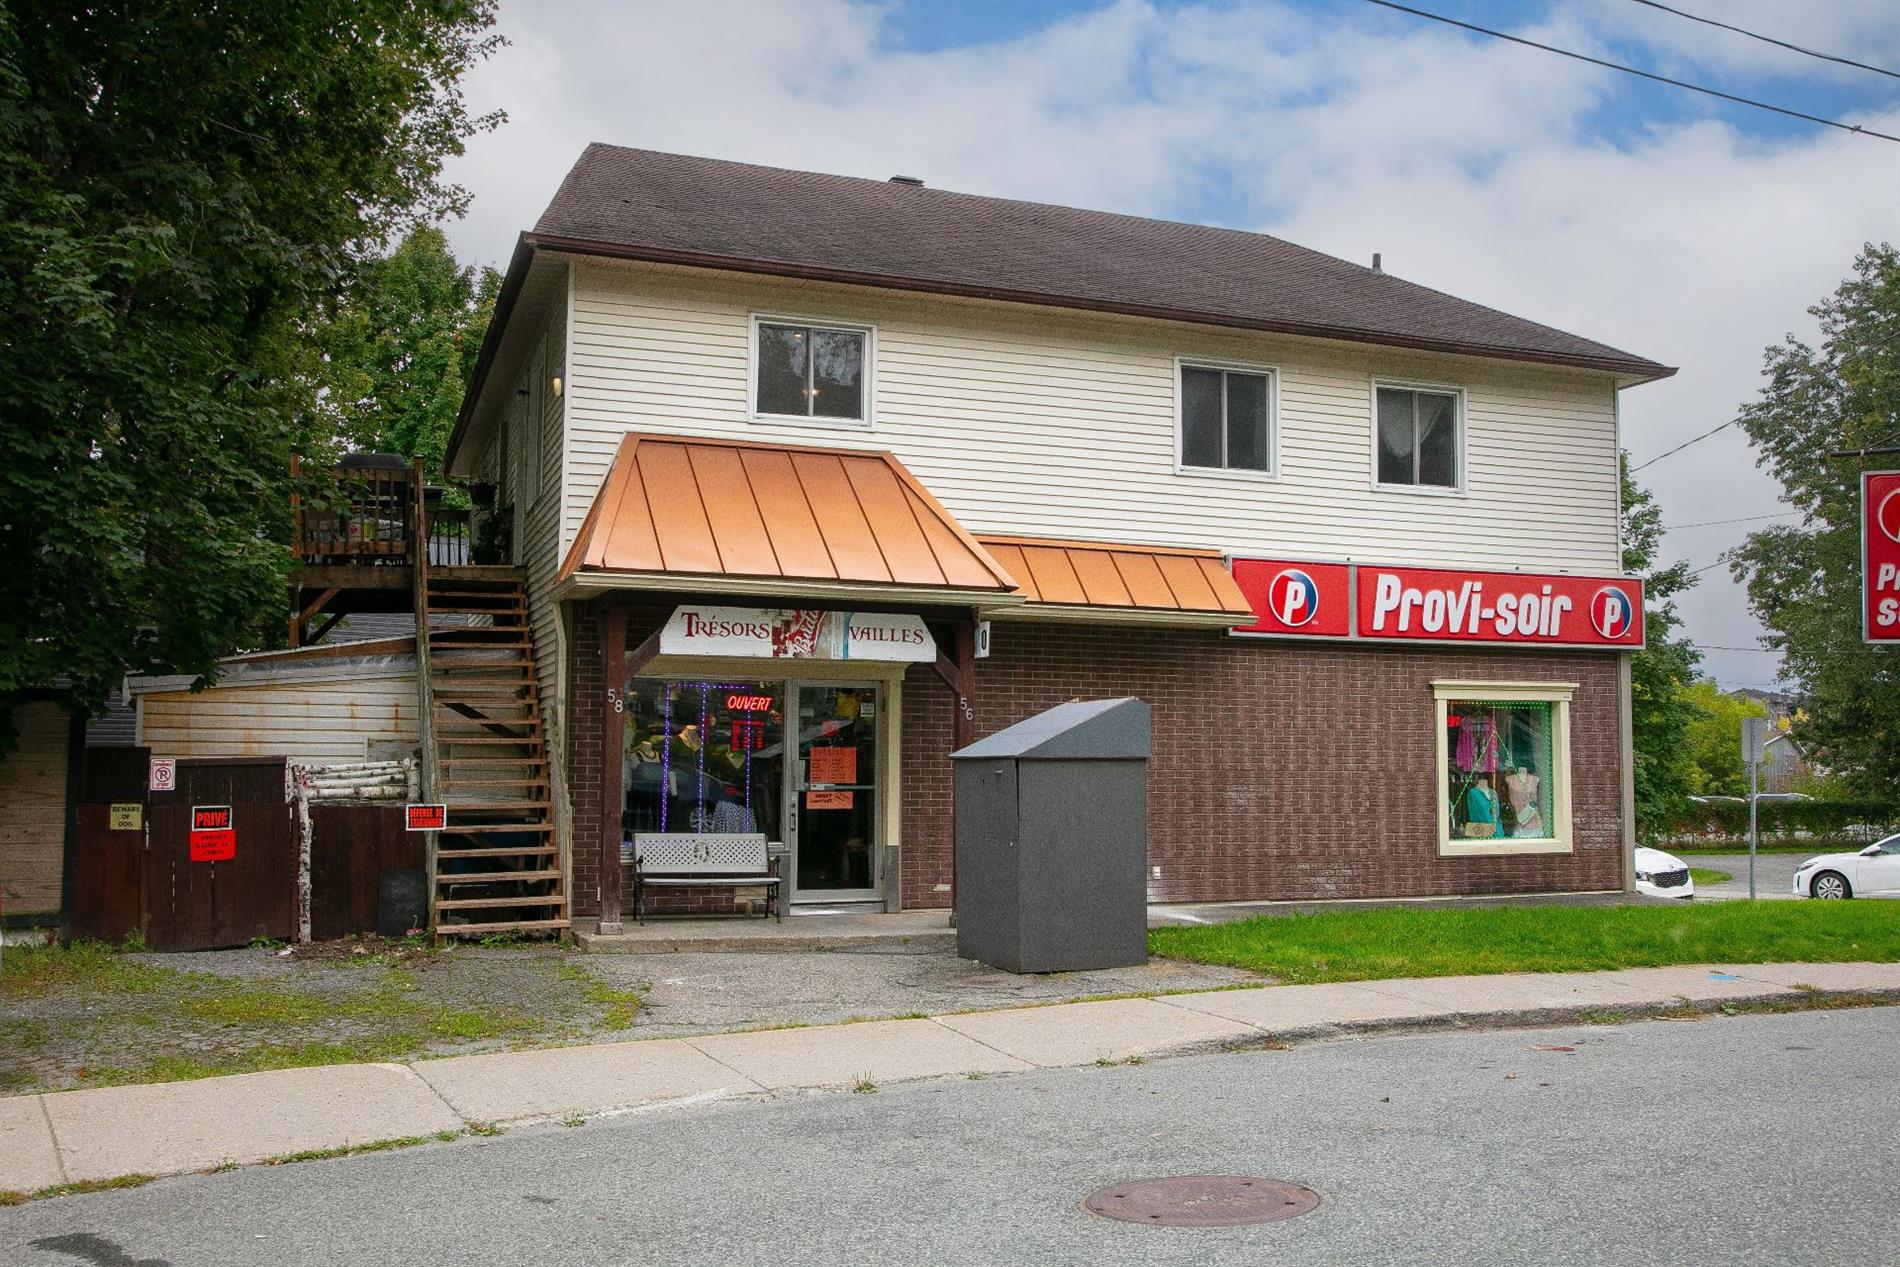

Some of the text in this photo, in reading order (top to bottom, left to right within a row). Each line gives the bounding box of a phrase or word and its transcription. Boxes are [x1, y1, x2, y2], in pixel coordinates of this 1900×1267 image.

[1876, 597, 1900, 627] S
[607, 688, 623, 713] 58
[727, 695, 773, 711] OUVERT
[960, 697, 973, 720] 56
[118, 820, 134, 828] DOG
[195, 809, 229, 827] PRIVÉ
